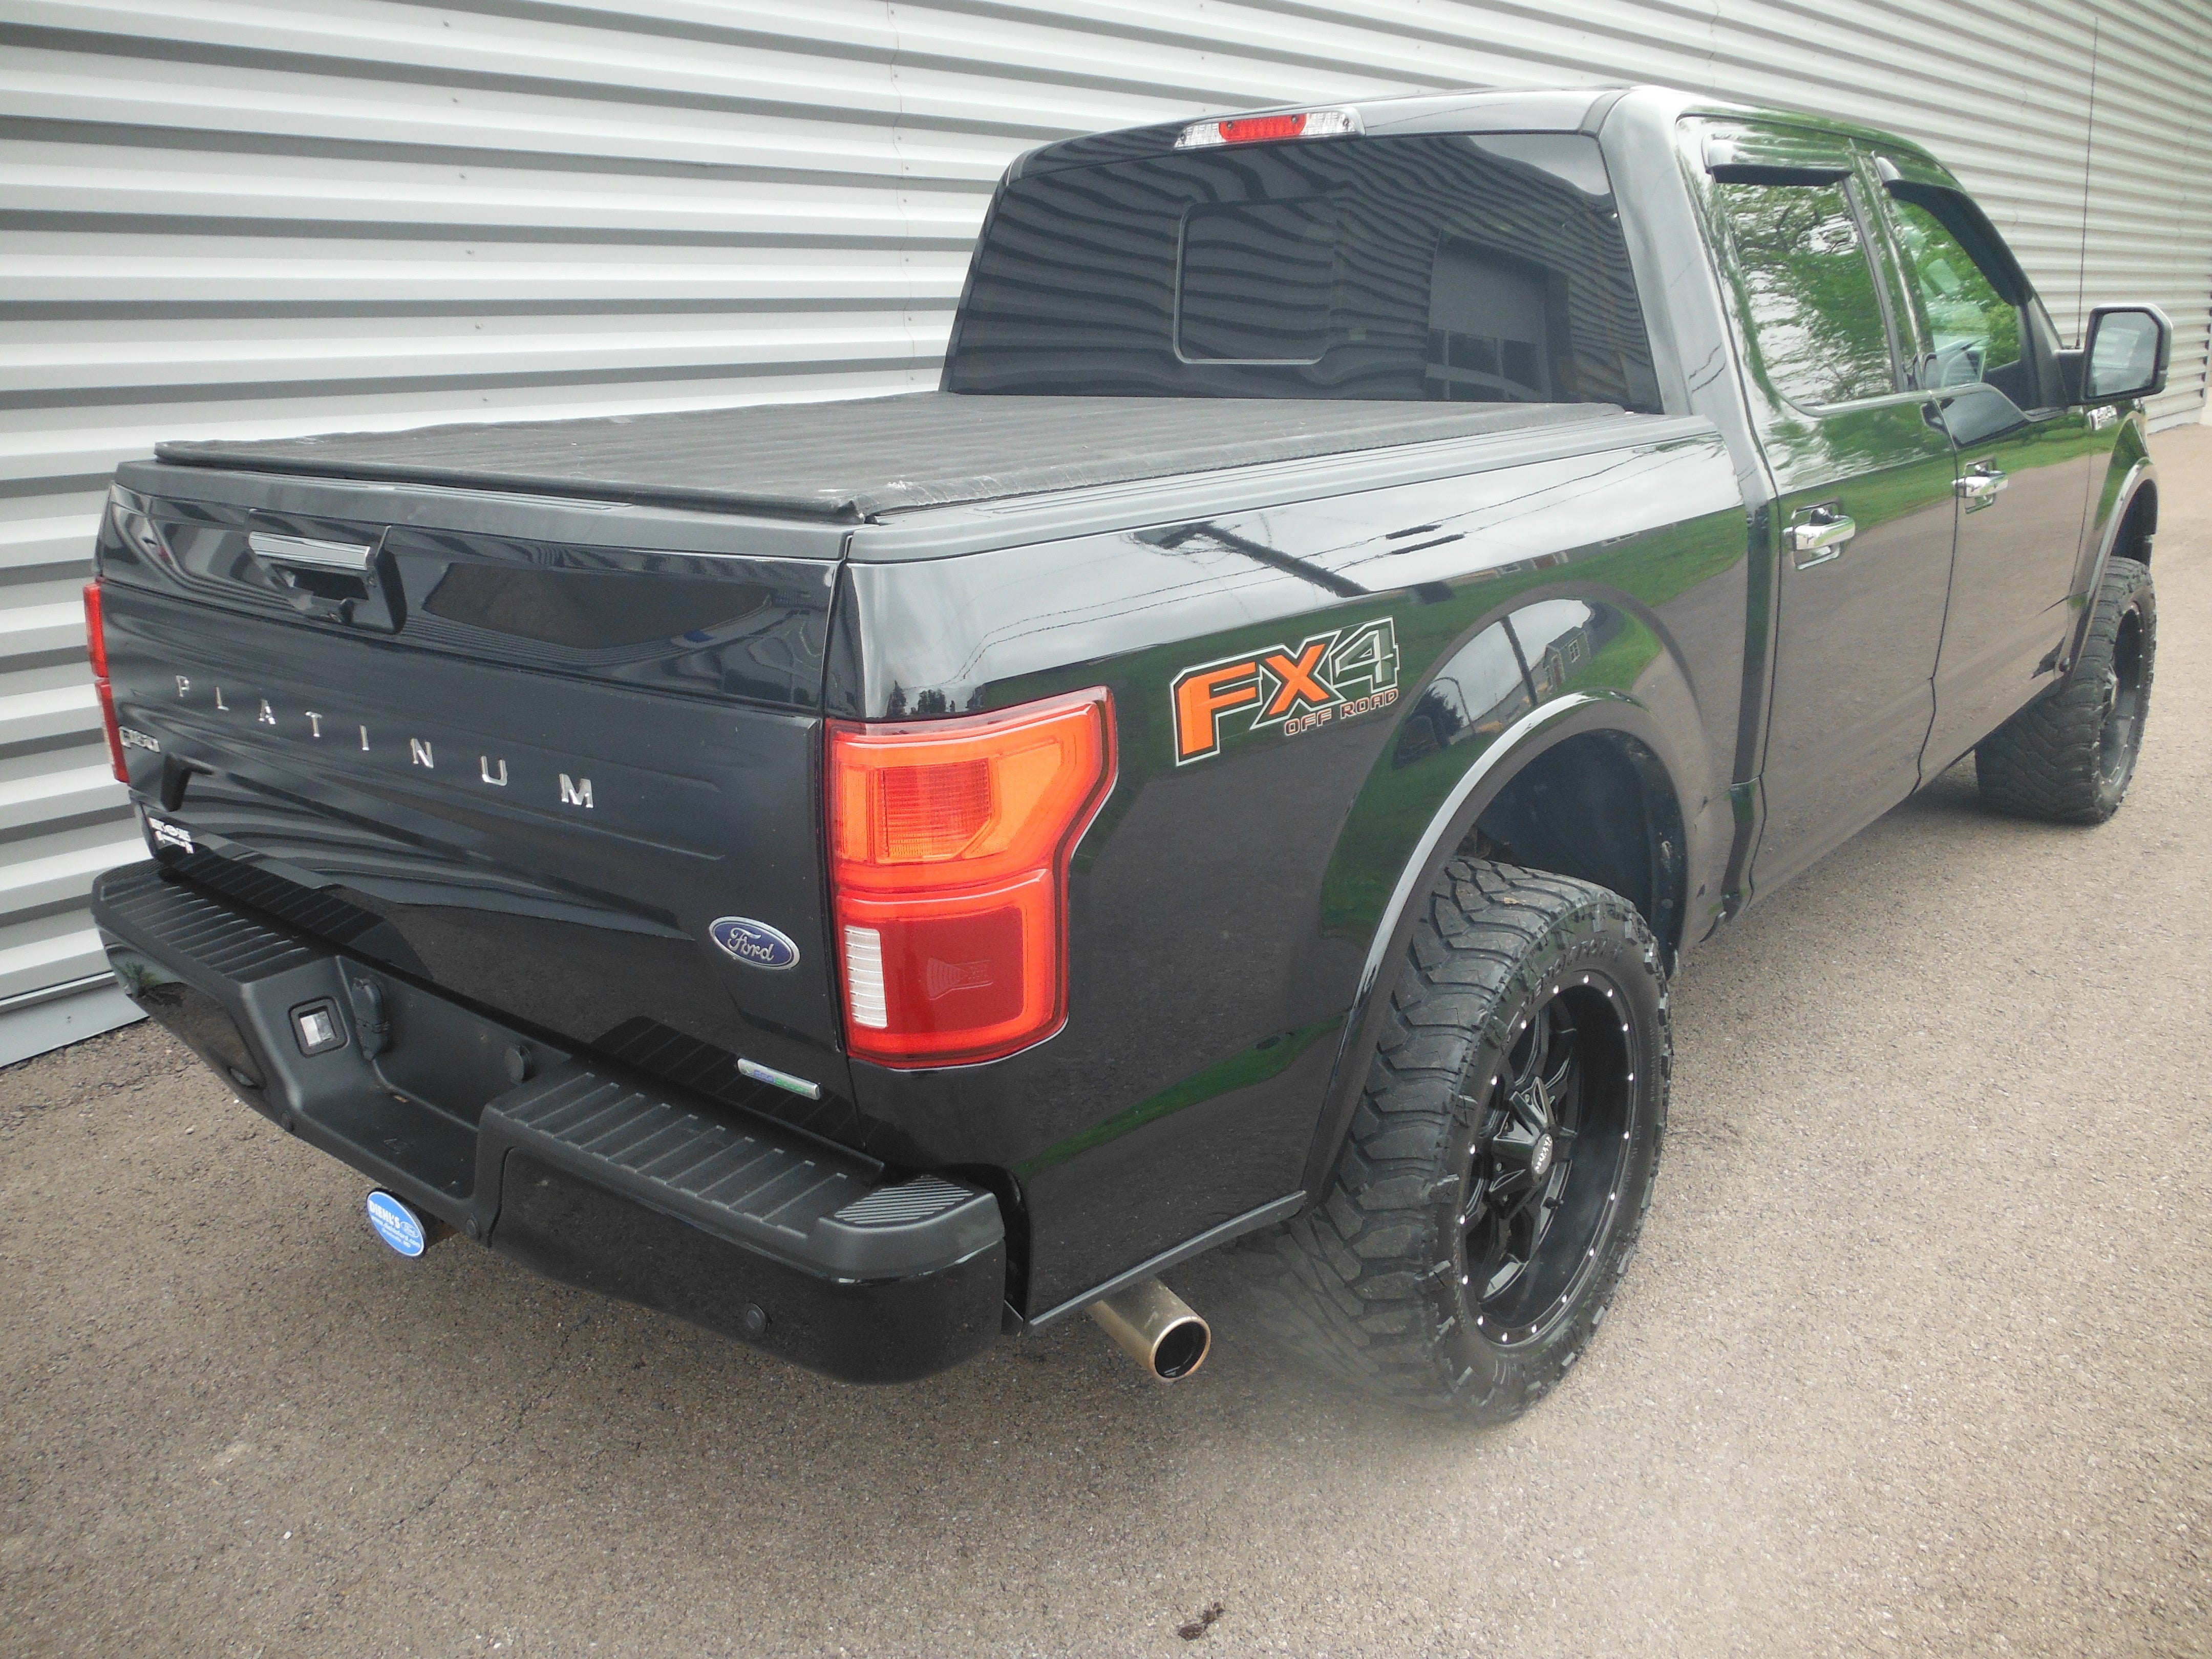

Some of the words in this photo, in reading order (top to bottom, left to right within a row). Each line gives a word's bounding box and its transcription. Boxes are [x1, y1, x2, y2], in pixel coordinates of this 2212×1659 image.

[1169, 615, 1399, 766] FX4
[1284, 708, 1332, 736] OFF
[1340, 688, 1399, 720] ROAD
[176, 675, 594, 809] PLATINUM
[727, 927, 774, 961] Ford
[369, 1199, 401, 1229] DIEHL'S
